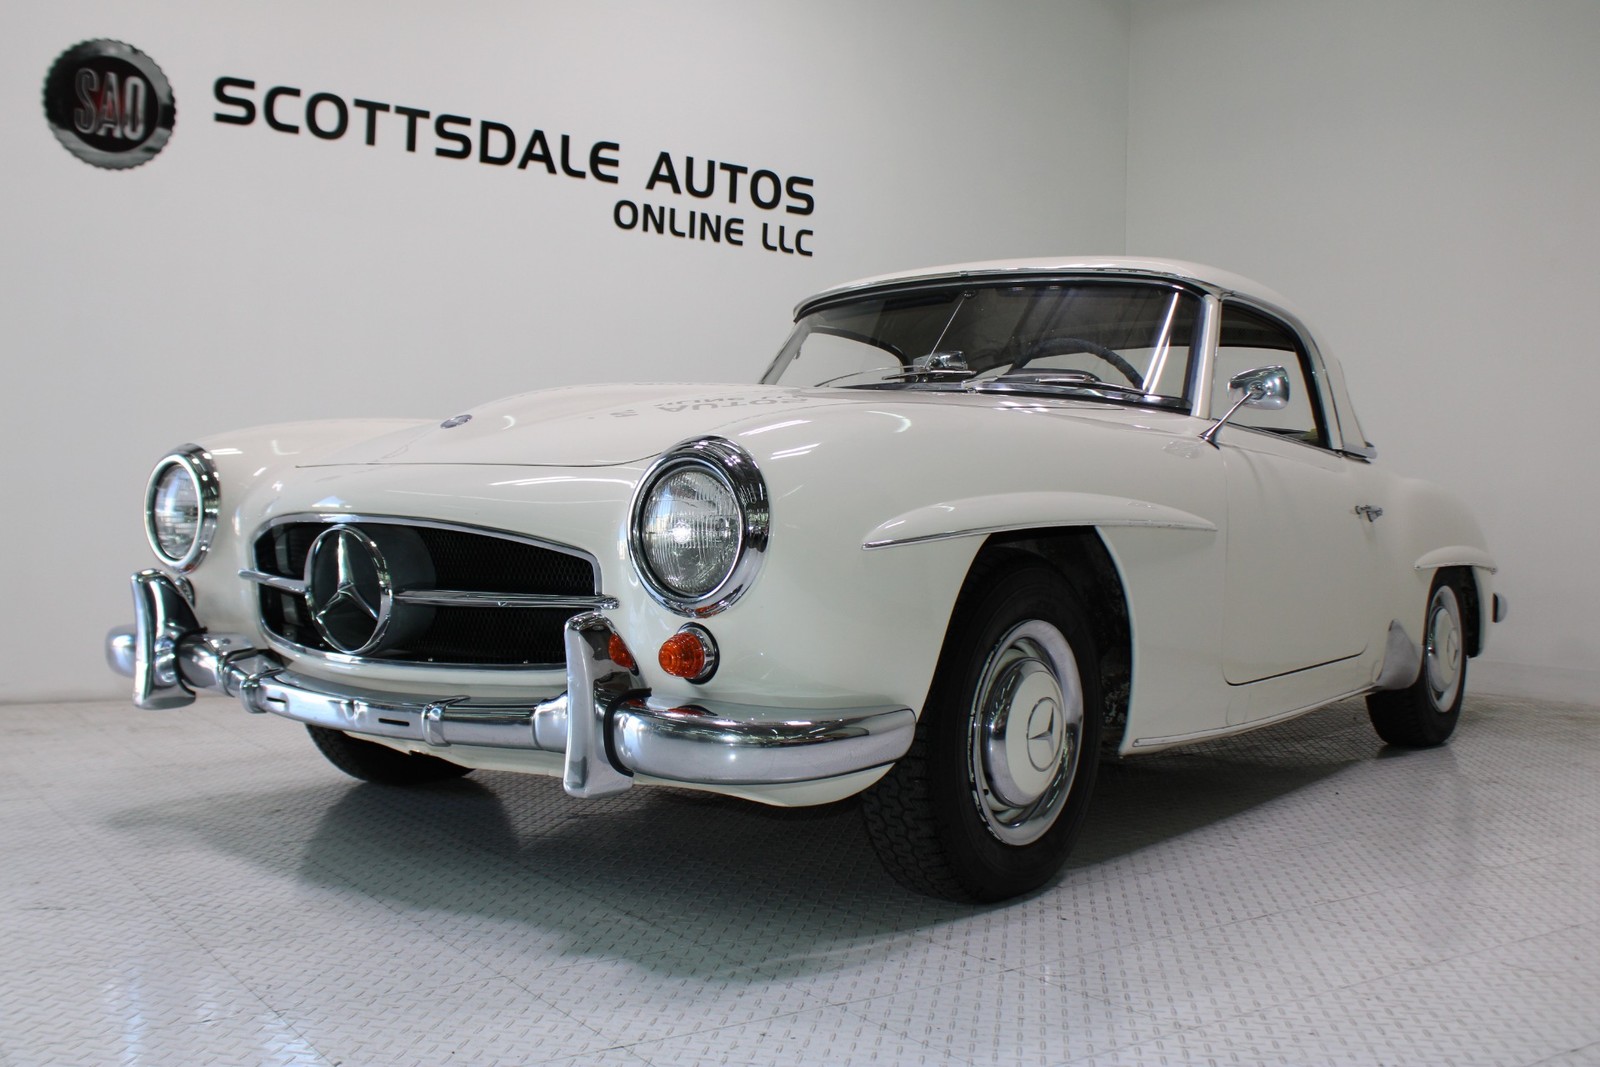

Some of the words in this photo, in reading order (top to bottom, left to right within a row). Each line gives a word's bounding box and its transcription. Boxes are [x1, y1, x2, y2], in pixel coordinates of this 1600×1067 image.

[74, 67, 146, 141] SAO
[213, 76, 620, 185] SCOTTSDALE
[645, 151, 815, 216] AUTOS
[613, 199, 744, 247] ONLINE
[761, 222, 814, 257] LLC
